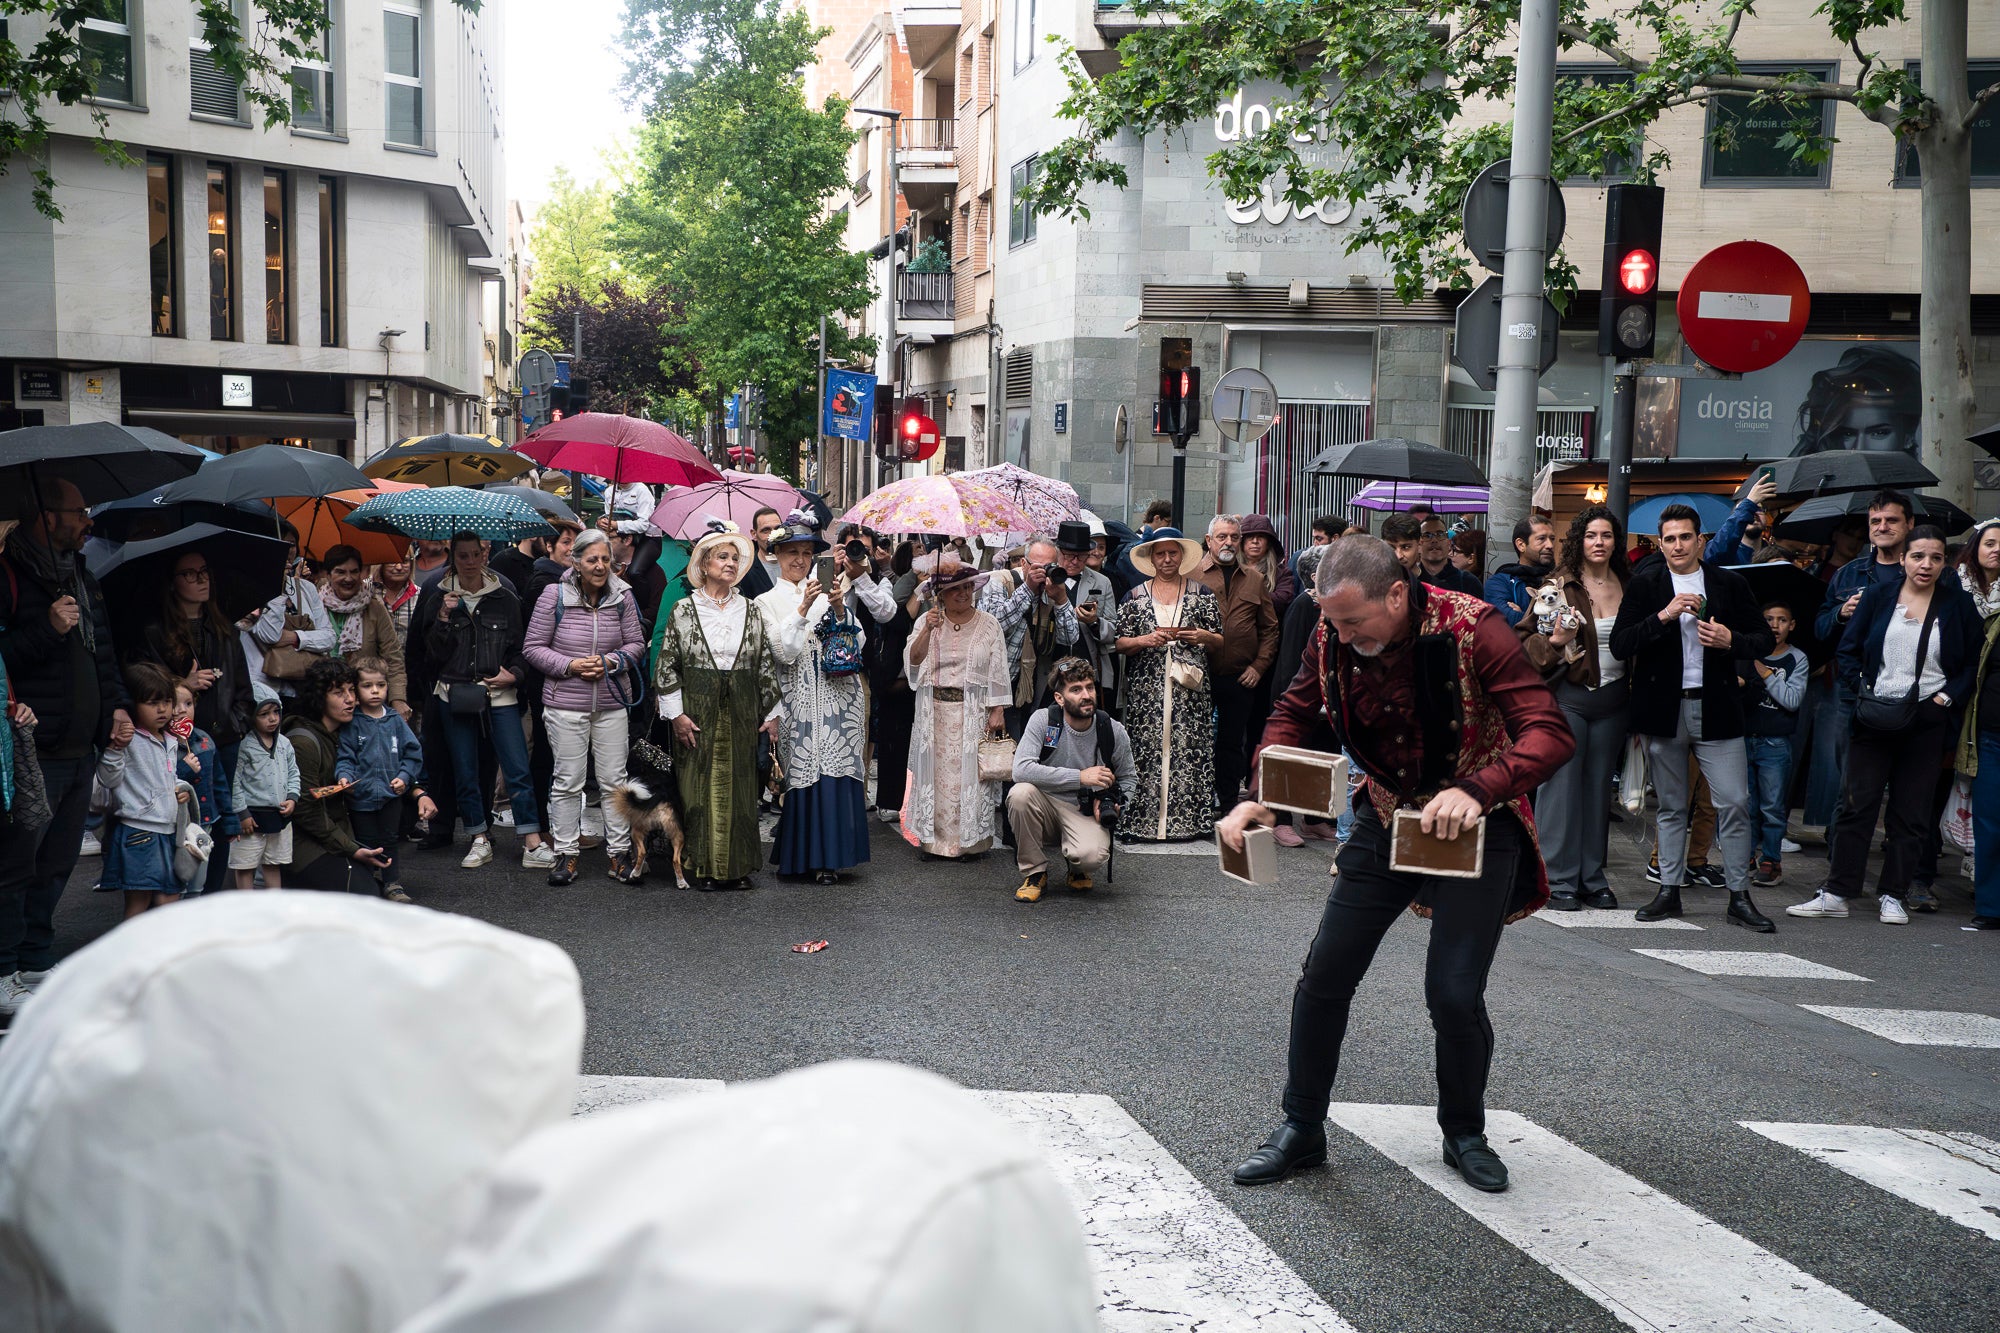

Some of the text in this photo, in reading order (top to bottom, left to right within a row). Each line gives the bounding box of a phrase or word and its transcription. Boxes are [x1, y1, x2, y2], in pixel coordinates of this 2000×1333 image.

[230, 382, 245, 391] 365
[1697, 392, 1773, 420] dorsia
[1535, 431, 1584, 449] dorsia
